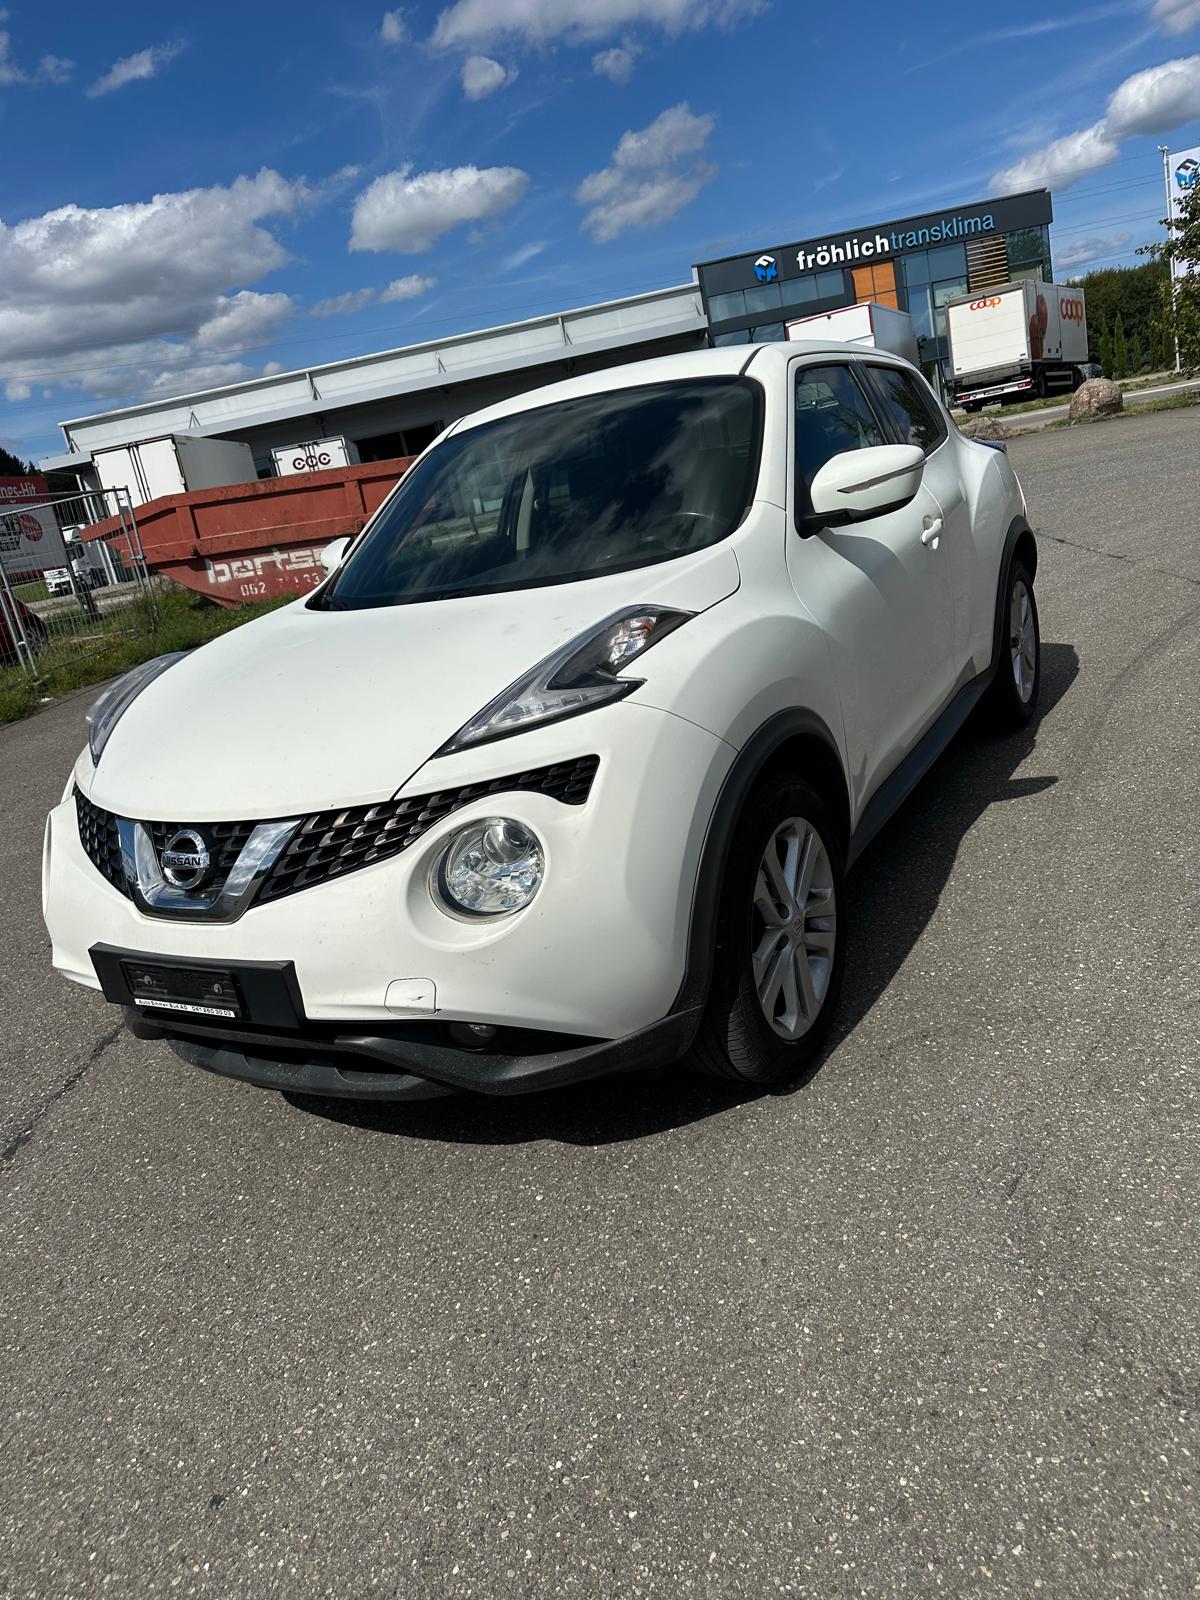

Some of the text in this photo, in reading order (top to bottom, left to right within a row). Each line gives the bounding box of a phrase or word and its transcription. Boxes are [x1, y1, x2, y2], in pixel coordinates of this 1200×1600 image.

[970, 296, 1001, 311] coop
[1060, 298, 1083, 327] coop
[164, 855, 201, 866] NISSAN
